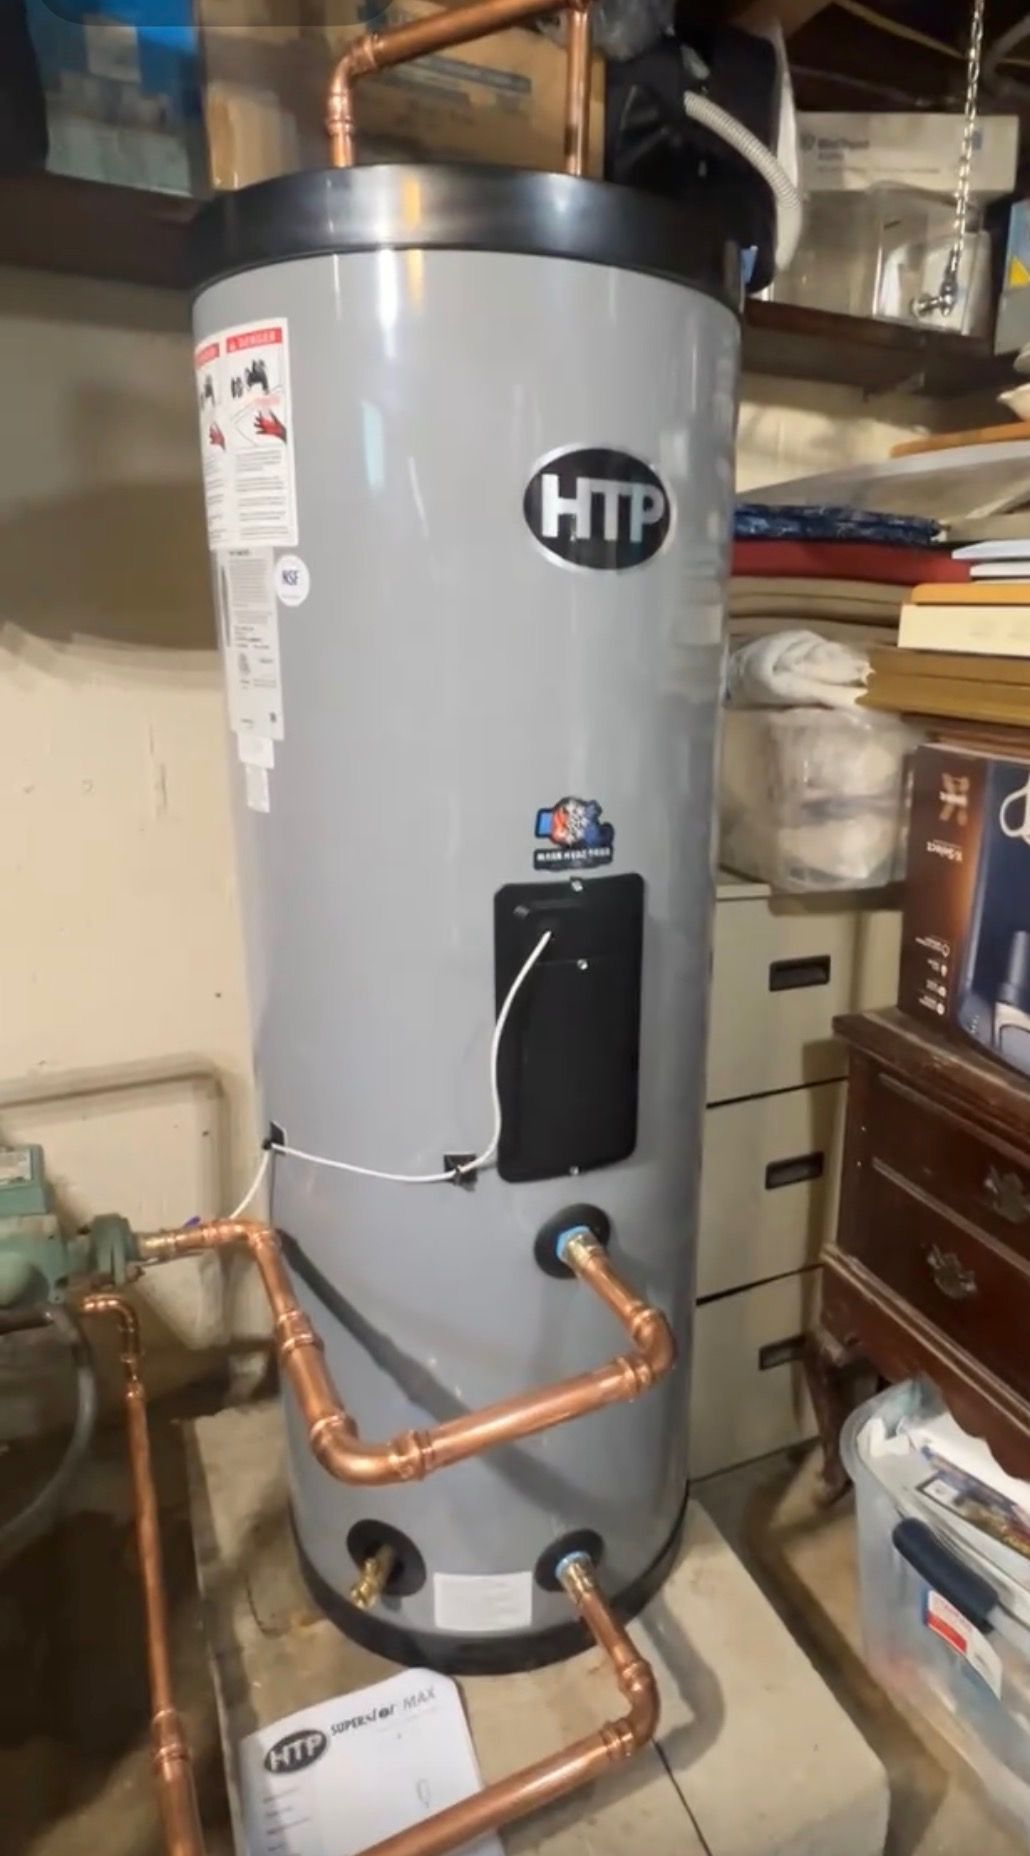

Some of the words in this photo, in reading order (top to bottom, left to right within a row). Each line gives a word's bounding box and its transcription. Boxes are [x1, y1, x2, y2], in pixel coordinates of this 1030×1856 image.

[541, 474, 665, 543] HTP
[282, 569, 300, 586] NSF
[402, 1686, 436, 1711] MAX
[270, 1734, 322, 1772] HTP
